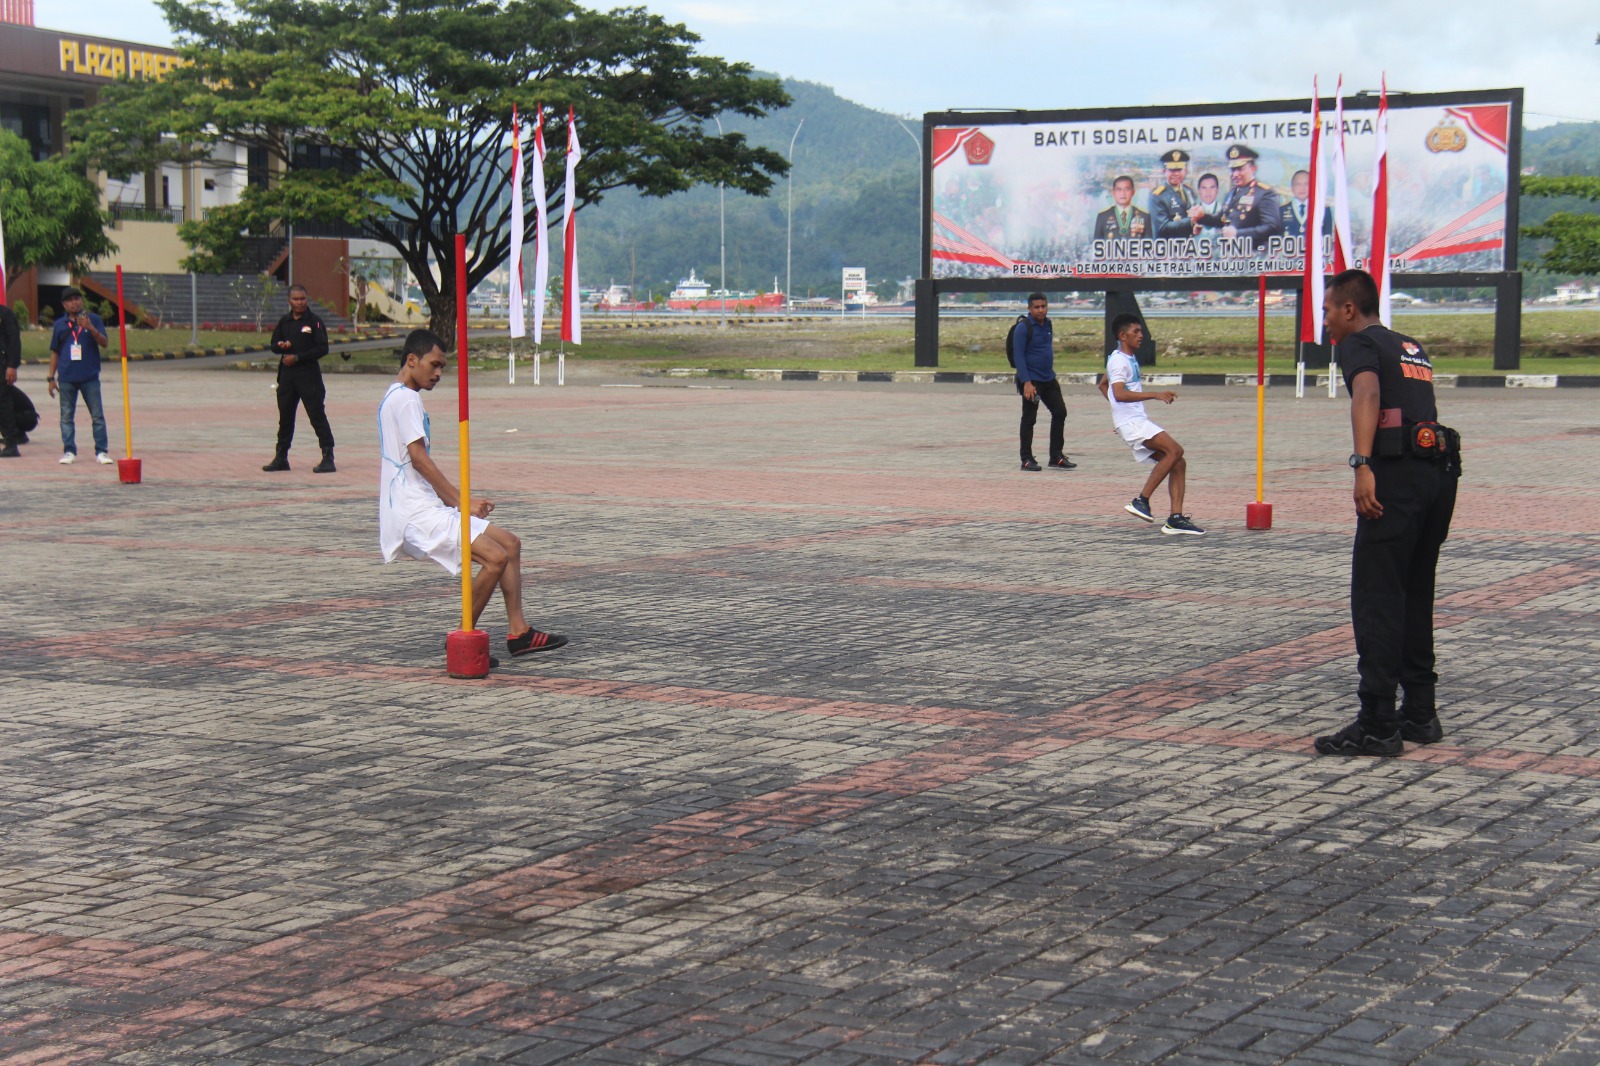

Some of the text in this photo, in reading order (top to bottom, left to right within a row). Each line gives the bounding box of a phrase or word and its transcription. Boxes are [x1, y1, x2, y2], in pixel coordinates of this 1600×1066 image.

[60, 39, 125, 78] PLAZA
[1034, 119, 1386, 146] BAKTI SOSIAL DAN BAKTI KESHATA
[1094, 238, 1211, 259] SINERGITAS
[1218, 236, 1252, 258] TNI
[1268, 235, 1330, 257] POLI
[1013, 264, 1073, 274] PENGAWAL
[1077, 263, 1142, 273] DEMOKRASI
[1147, 262, 1191, 273] NETRAL
[1196, 261, 1244, 272] MENUJU
[1249, 260, 1292, 271] PEMILU
